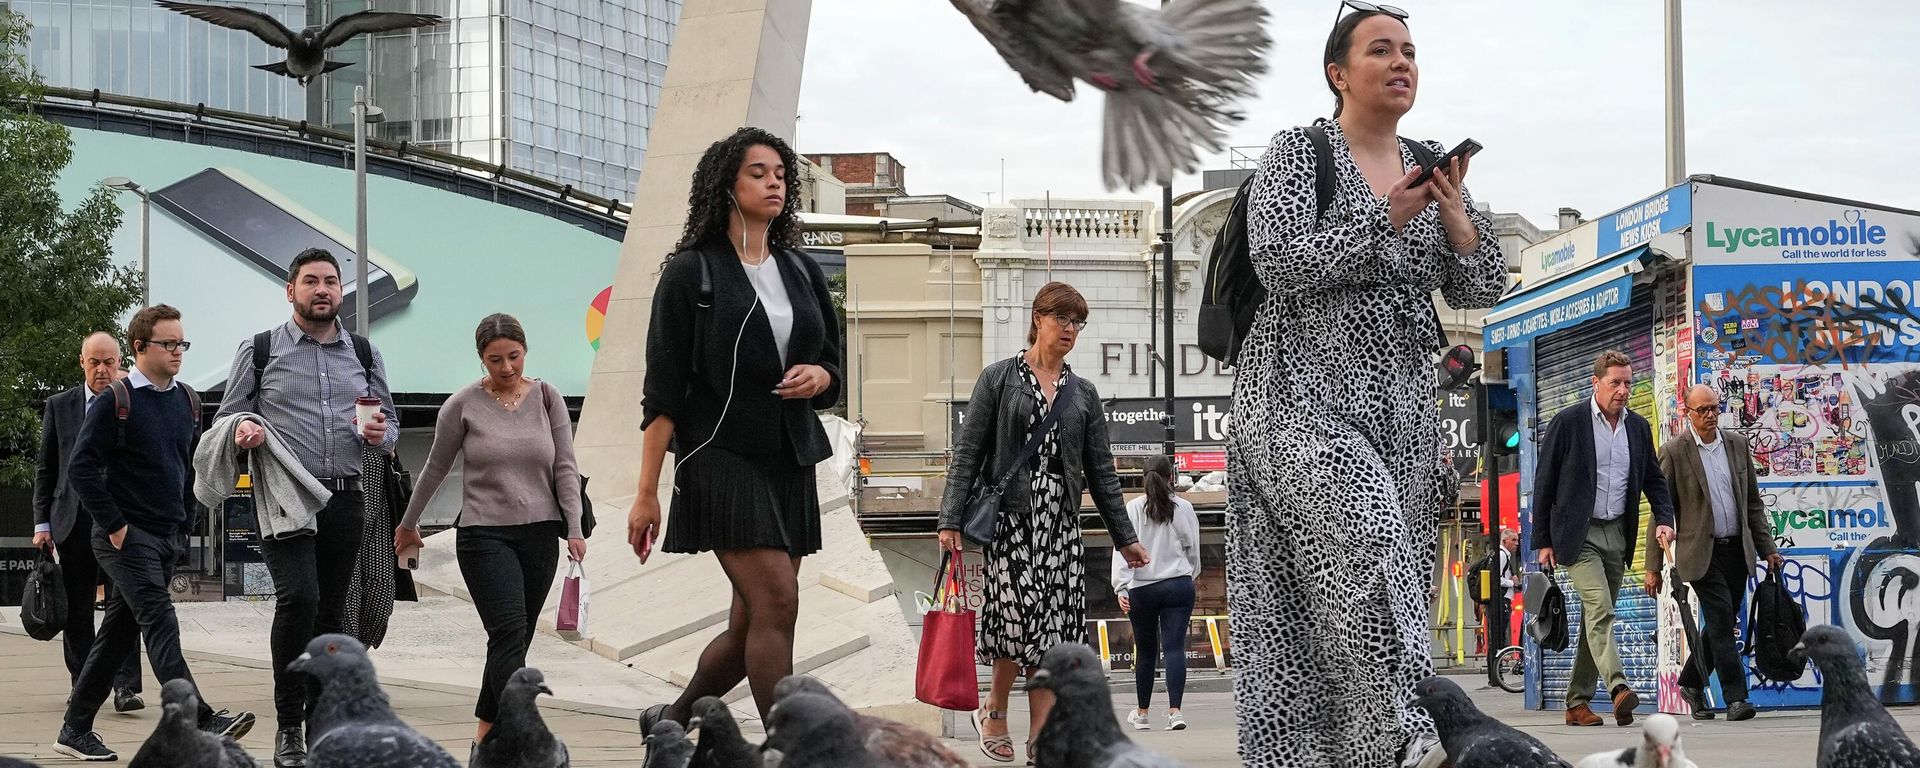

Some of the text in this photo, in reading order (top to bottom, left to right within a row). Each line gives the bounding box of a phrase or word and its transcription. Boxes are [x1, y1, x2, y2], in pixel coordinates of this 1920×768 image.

[1615, 194, 1669, 231] LONDON BRIDGE
[1620, 218, 1661, 249] NEWS KIOSK
[1705, 219, 1887, 253] Lycamobile
[1541, 240, 1576, 272] Lycamobile
[1782, 248, 1887, 259] Call the world for less
[1523, 312, 1547, 335] CIGARETTES
[1596, 287, 1619, 310] ADAPTOR
[1449, 393, 1466, 407] itc
[1112, 408, 1166, 425] togethe
[1450, 450, 1479, 458] EARS
[1768, 502, 1889, 535] ycamob
[1829, 532, 1867, 541] Call the
[9, 560, 37, 571] PAR
